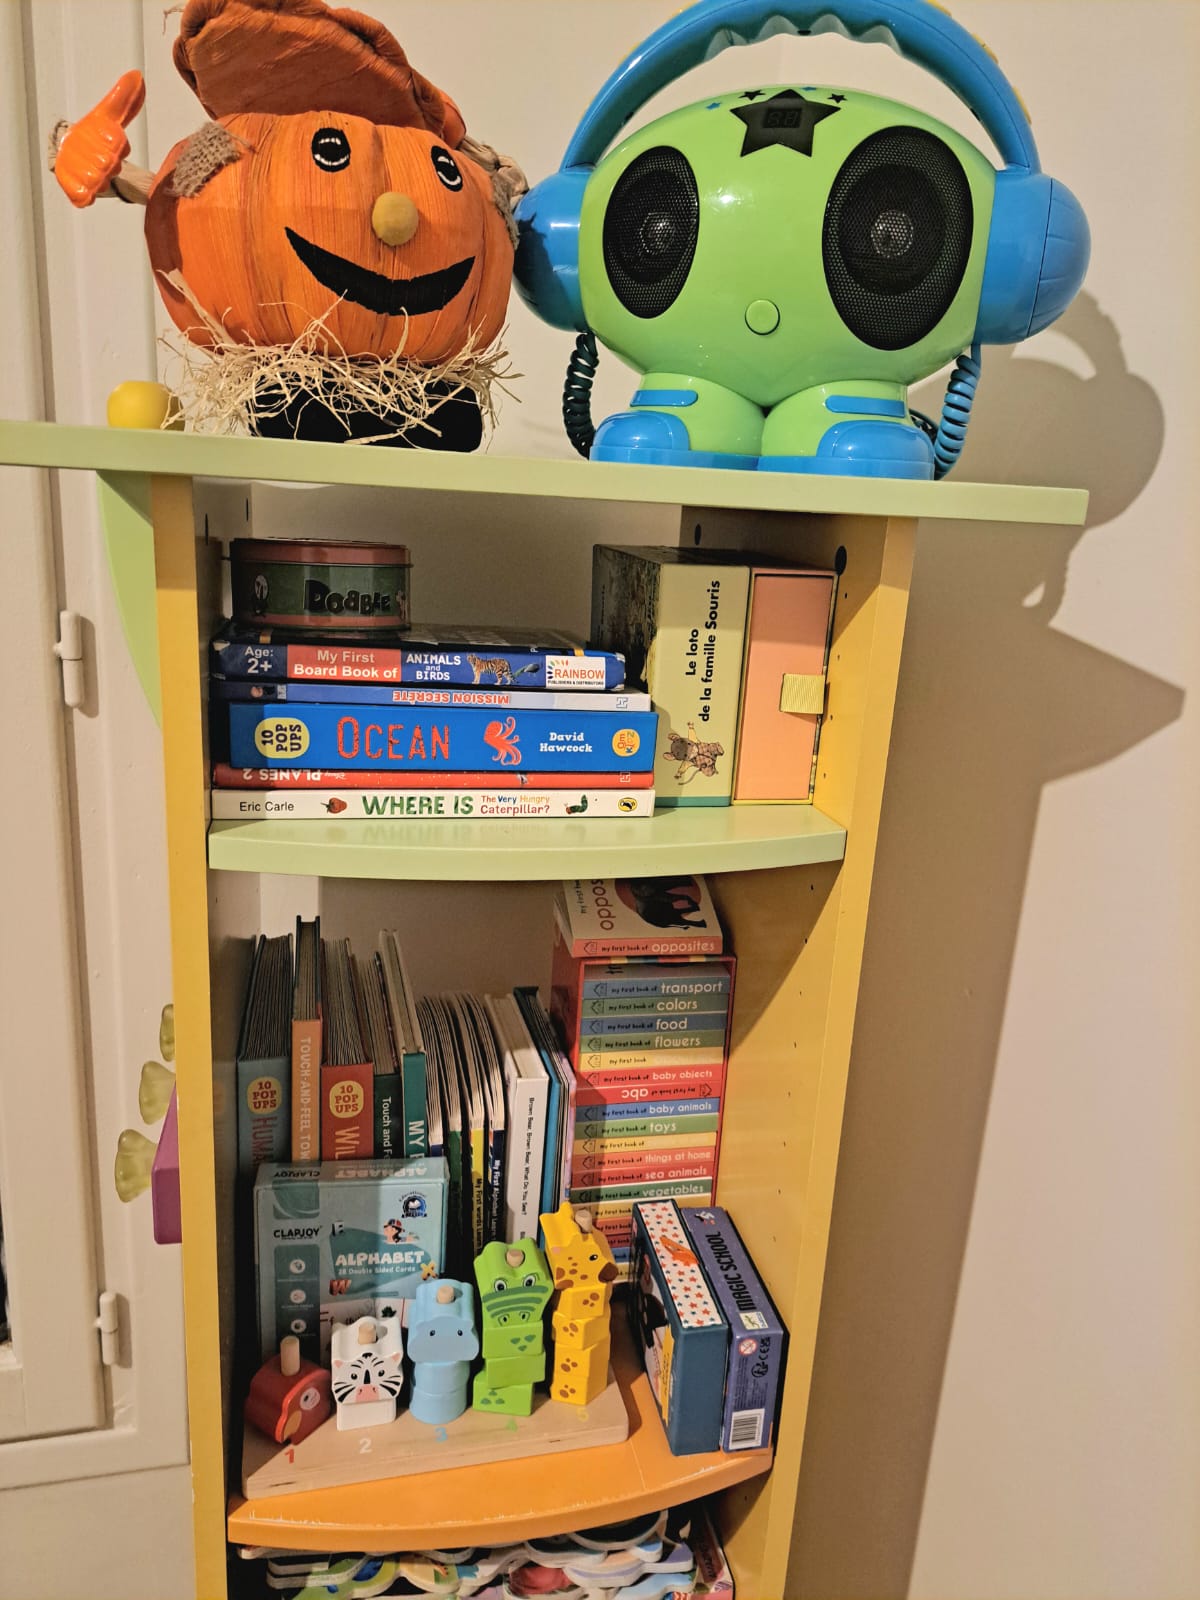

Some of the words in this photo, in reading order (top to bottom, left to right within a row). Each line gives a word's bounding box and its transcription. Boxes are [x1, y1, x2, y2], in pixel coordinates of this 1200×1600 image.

[705, 580, 721, 630] Souris
[686, 628, 699, 658] loto
[244, 646, 274, 659] Age:
[317, 650, 337, 664] My
[342, 650, 375, 663] First
[701, 634, 716, 683] famille
[247, 658, 273, 674] 2+
[406, 653, 461, 666] ANIMALS
[294, 664, 338, 676] Board
[342, 665, 380, 678] Book
[383, 667, 397, 679] of
[425, 663, 441, 672] and
[554, 667, 605, 680] RAINBOW
[685, 661, 697, 676] Le
[415, 670, 450, 681] BIRDS
[393, 690, 450, 706] SECRÈTE
[453, 693, 511, 705] MISSION
[699, 687, 712, 704] la
[698, 705, 710, 722] de
[261, 729, 274, 747] 10
[276, 723, 288, 752] POP
[290, 723, 302, 752] UPS
[549, 731, 584, 743] David
[539, 743, 593, 753] Hawcock
[259, 768, 321, 781] PLANES
[362, 795, 445, 815] WHERE
[454, 795, 474, 815] IS
[481, 795, 497, 803] The
[497, 795, 517, 805] Very
[519, 794, 550, 805] Hungry
[239, 801, 261, 812] Eric
[264, 801, 294, 812] Carle
[480, 804, 550, 816] Caterpillar?
[651, 940, 715, 954] opposites
[660, 981, 722, 995] transport
[656, 998, 698, 1011] colors
[656, 1018, 688, 1030] food
[654, 1036, 701, 1048] flowers
[652, 1071, 677, 1082] baby
[679, 1070, 713, 1080] objects
[258, 1081, 272, 1090] 10
[339, 1085, 353, 1094] 10
[252, 1089, 277, 1100] POP
[334, 1094, 359, 1105] POP
[621, 1088, 649, 1100] abc
[253, 1098, 277, 1110] UPS
[335, 1103, 359, 1113] UPS
[382, 1096, 392, 1125] Touch
[649, 1103, 674, 1114] baby
[678, 1101, 712, 1112] animals
[408, 1120, 425, 1147] MY
[650, 1122, 678, 1134] toys
[382, 1127, 391, 1148] and
[644, 1153, 672, 1165] things
[674, 1152, 686, 1161] at
[688, 1149, 711, 1160] home
[274, 1170, 321, 1178] CLAPJOY
[645, 1169, 664, 1180] sea
[668, 1166, 708, 1178] animals
[642, 1184, 704, 1198] vegetables
[273, 1227, 320, 1239] CLAPJOY
[335, 1251, 425, 1266] ALPHABET
[706, 1231, 738, 1273] SCHOOL
[395, 1265, 416, 1274] Cards
[726, 1272, 758, 1312] MAGIC
[434, 1426, 448, 1442] 3
[358, 1437, 373, 1454] 2
[284, 1448, 295, 1464] 1
